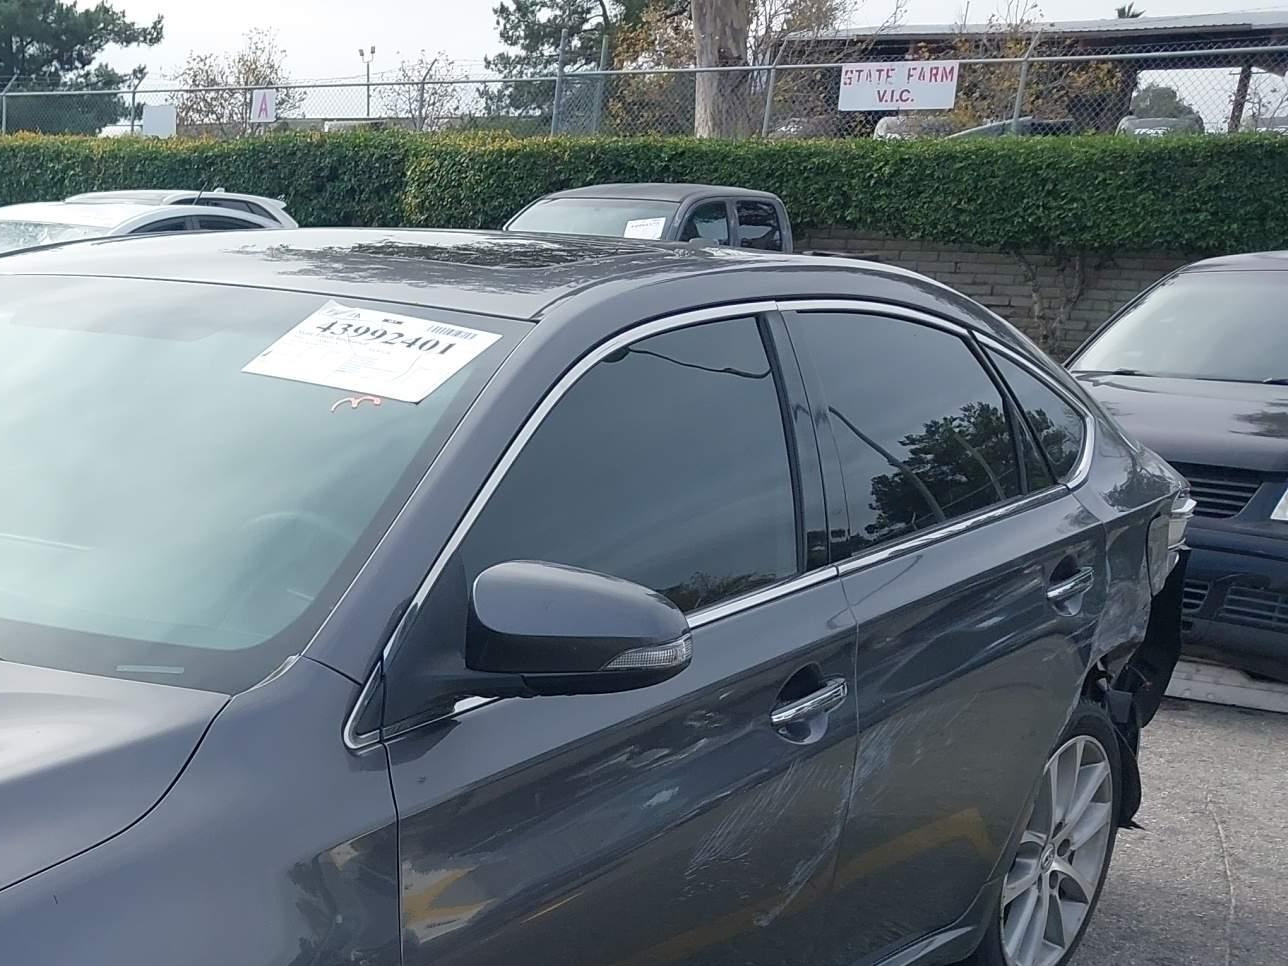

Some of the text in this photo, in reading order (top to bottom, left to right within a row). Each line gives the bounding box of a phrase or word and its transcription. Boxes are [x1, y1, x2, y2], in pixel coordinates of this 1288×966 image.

[843, 66, 955, 86] STATE FARM
[258, 91, 268, 118] A
[877, 89, 914, 103] V.I.C.
[315, 319, 457, 356] 43992401
